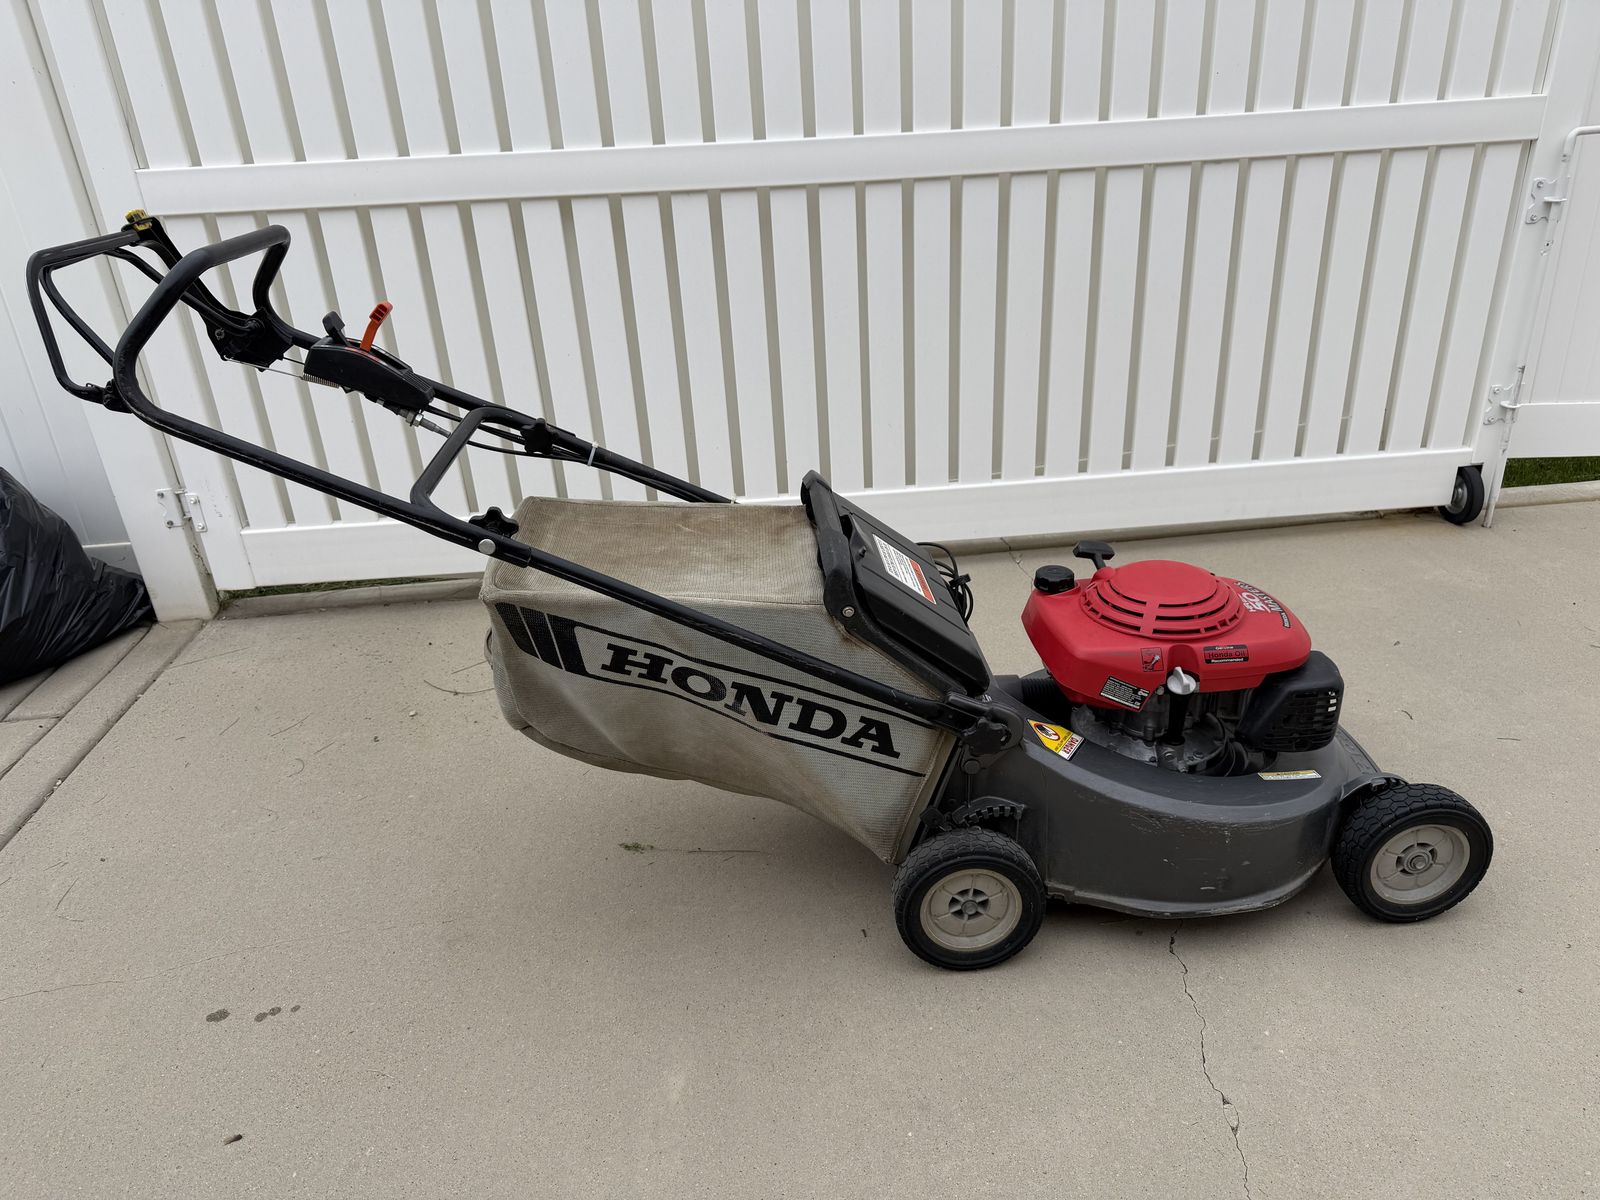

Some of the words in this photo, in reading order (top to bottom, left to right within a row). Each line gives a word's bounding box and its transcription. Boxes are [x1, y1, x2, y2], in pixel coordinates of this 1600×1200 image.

[1208, 650, 1233, 659] Honda
[1235, 649, 1246, 657] Oil
[601, 643, 900, 759] HONDA
[1062, 737, 1079, 754] DANGER
